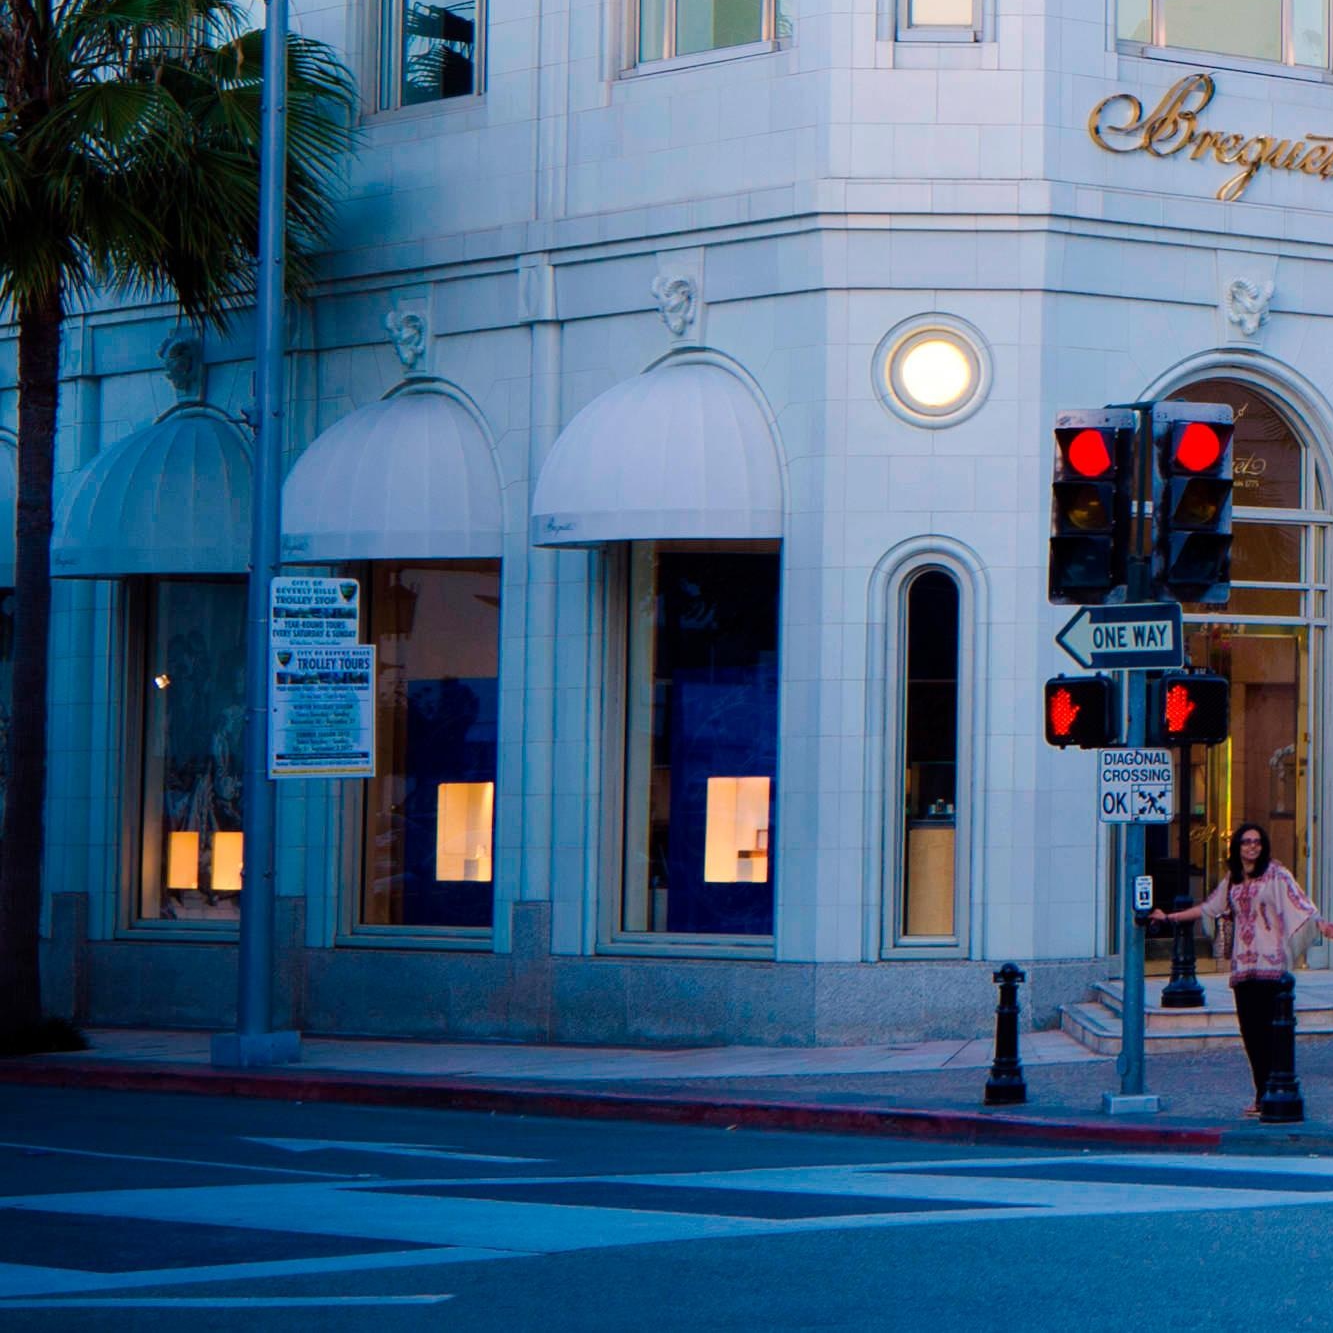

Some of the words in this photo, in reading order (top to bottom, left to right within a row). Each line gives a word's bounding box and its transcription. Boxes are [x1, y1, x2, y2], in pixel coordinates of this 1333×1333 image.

[275, 596, 312, 605] TROLLEY
[314, 596, 338, 605] STOP
[1093, 626, 1128, 650] ONE
[1133, 624, 1168, 647] WAY
[297, 658, 336, 670] TROLLEY
[339, 657, 370, 669] TOURS
[1104, 753, 1169, 765] DIAGONAL
[1103, 769, 1171, 782] CROSSING
[1103, 792, 1128, 815] OK
